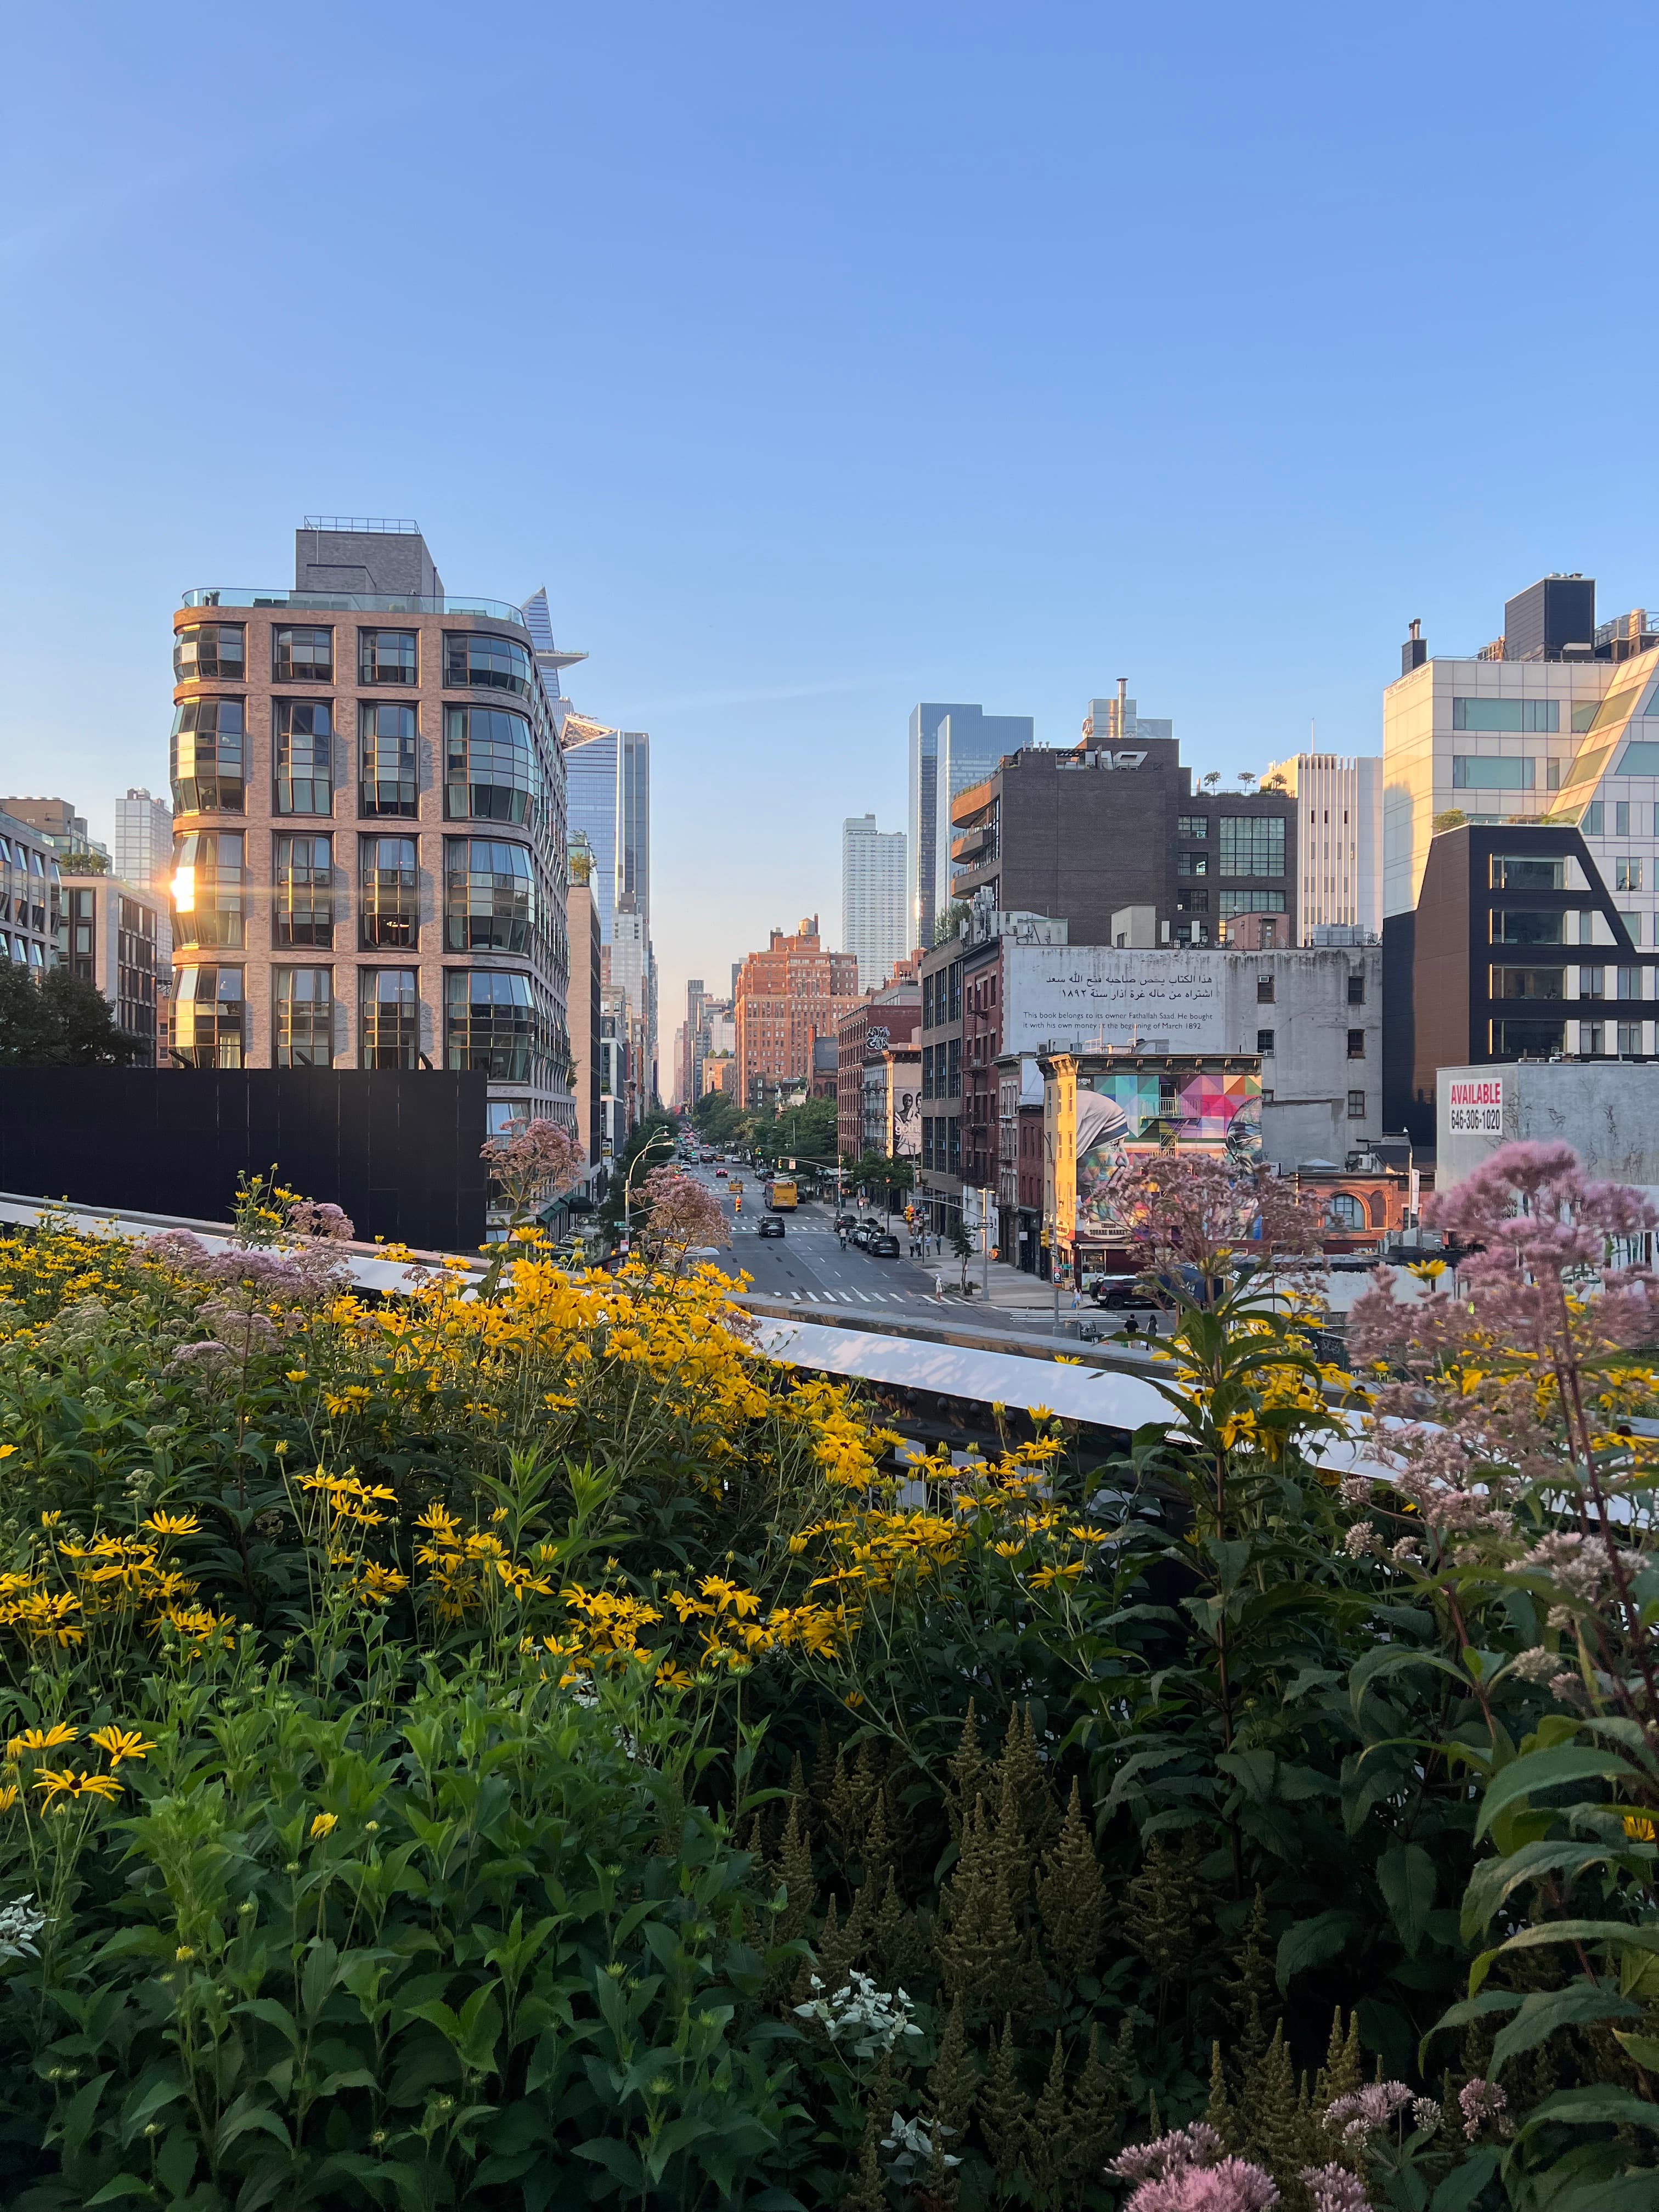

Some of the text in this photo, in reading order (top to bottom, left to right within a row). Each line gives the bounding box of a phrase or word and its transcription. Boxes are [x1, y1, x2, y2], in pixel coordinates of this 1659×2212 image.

[1069, 971, 1082, 983] الله
[1086, 975, 1102, 987] فتح
[1105, 975, 1136, 985] صاحبه
[1140, 976, 1165, 986] يخص
[1169, 974, 1195, 986] الكتاب
[1199, 974, 1212, 983] هذا
[1062, 989, 1086, 997] ١٨٩٢
[1090, 989, 1108, 997] سنة
[1149, 989, 1165, 997] ماله
[1169, 991, 1181, 1000] من
[1058, 1012, 1084, 1020] belongs
[1189, 1013, 1213, 1022] bought
[1451, 1083, 1500, 1104] AVAILABLE
[1452, 1109, 1500, 1130] 646-306-1020
